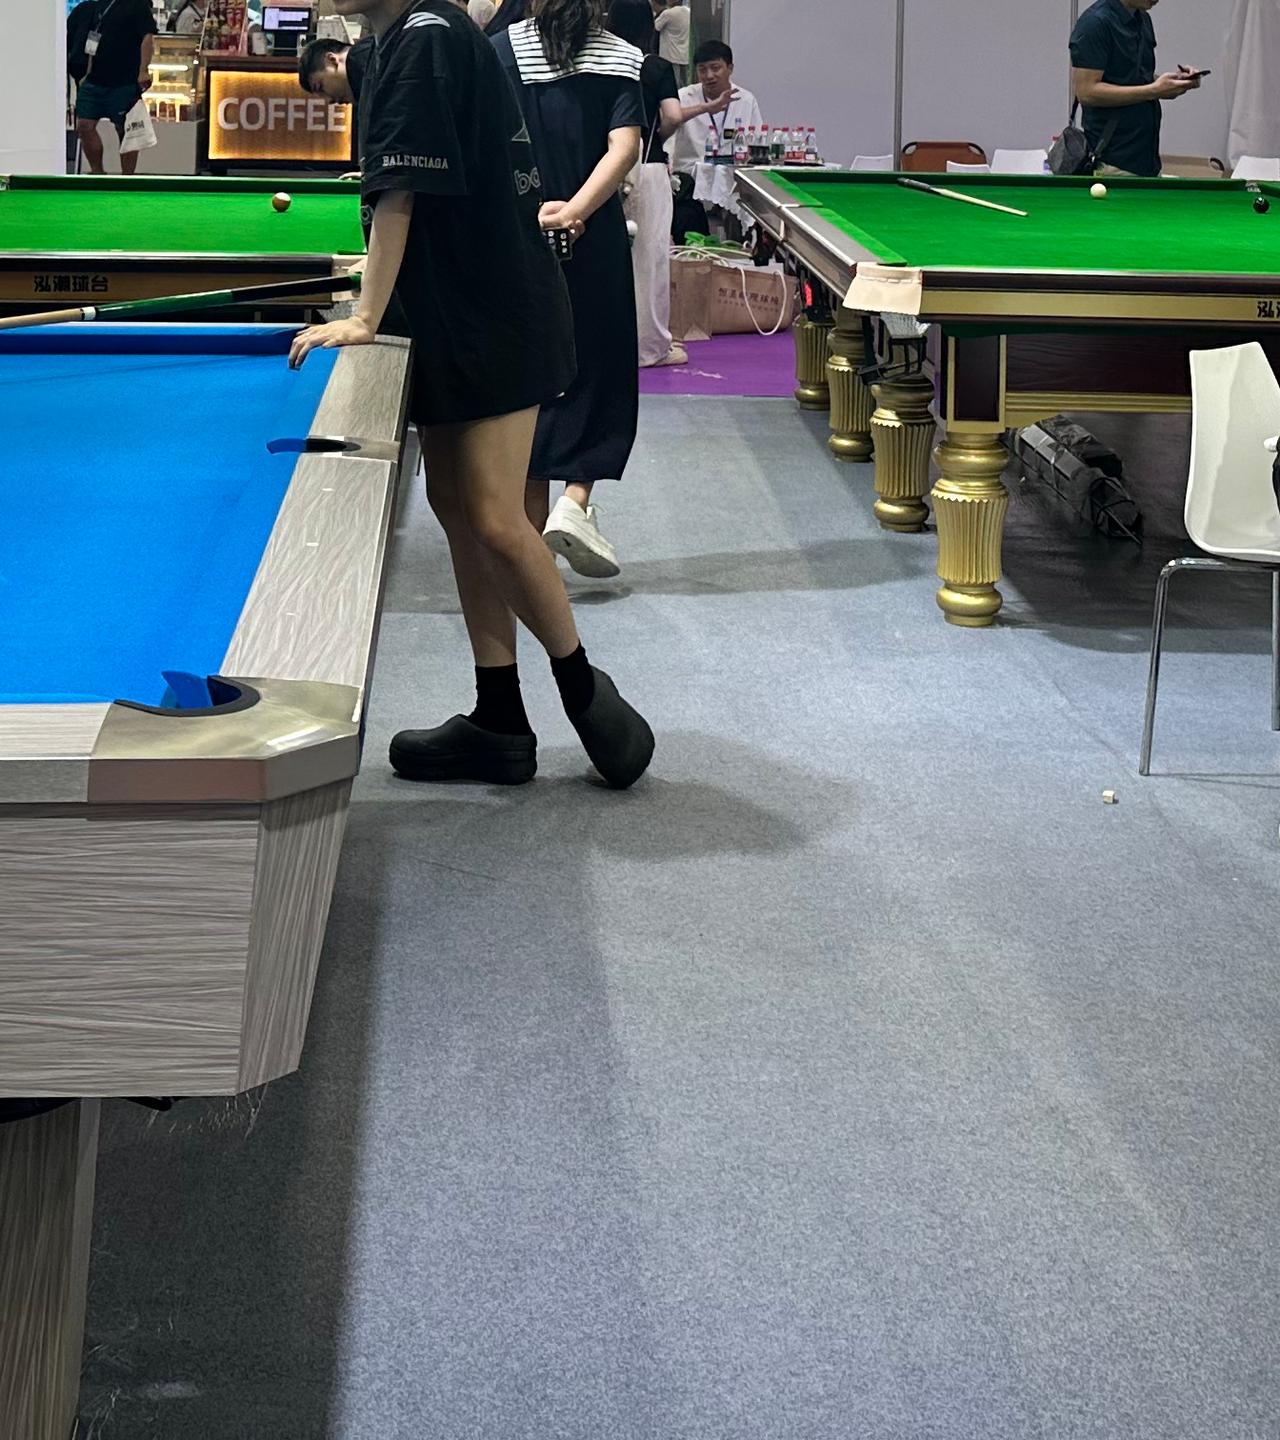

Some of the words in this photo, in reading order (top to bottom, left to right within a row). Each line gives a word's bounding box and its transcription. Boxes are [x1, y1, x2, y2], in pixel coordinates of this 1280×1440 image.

[217, 96, 347, 133] COFFEE
[381, 154, 449, 170] BALENCIAGA
[33, 274, 109, 293] 泓潮球台
